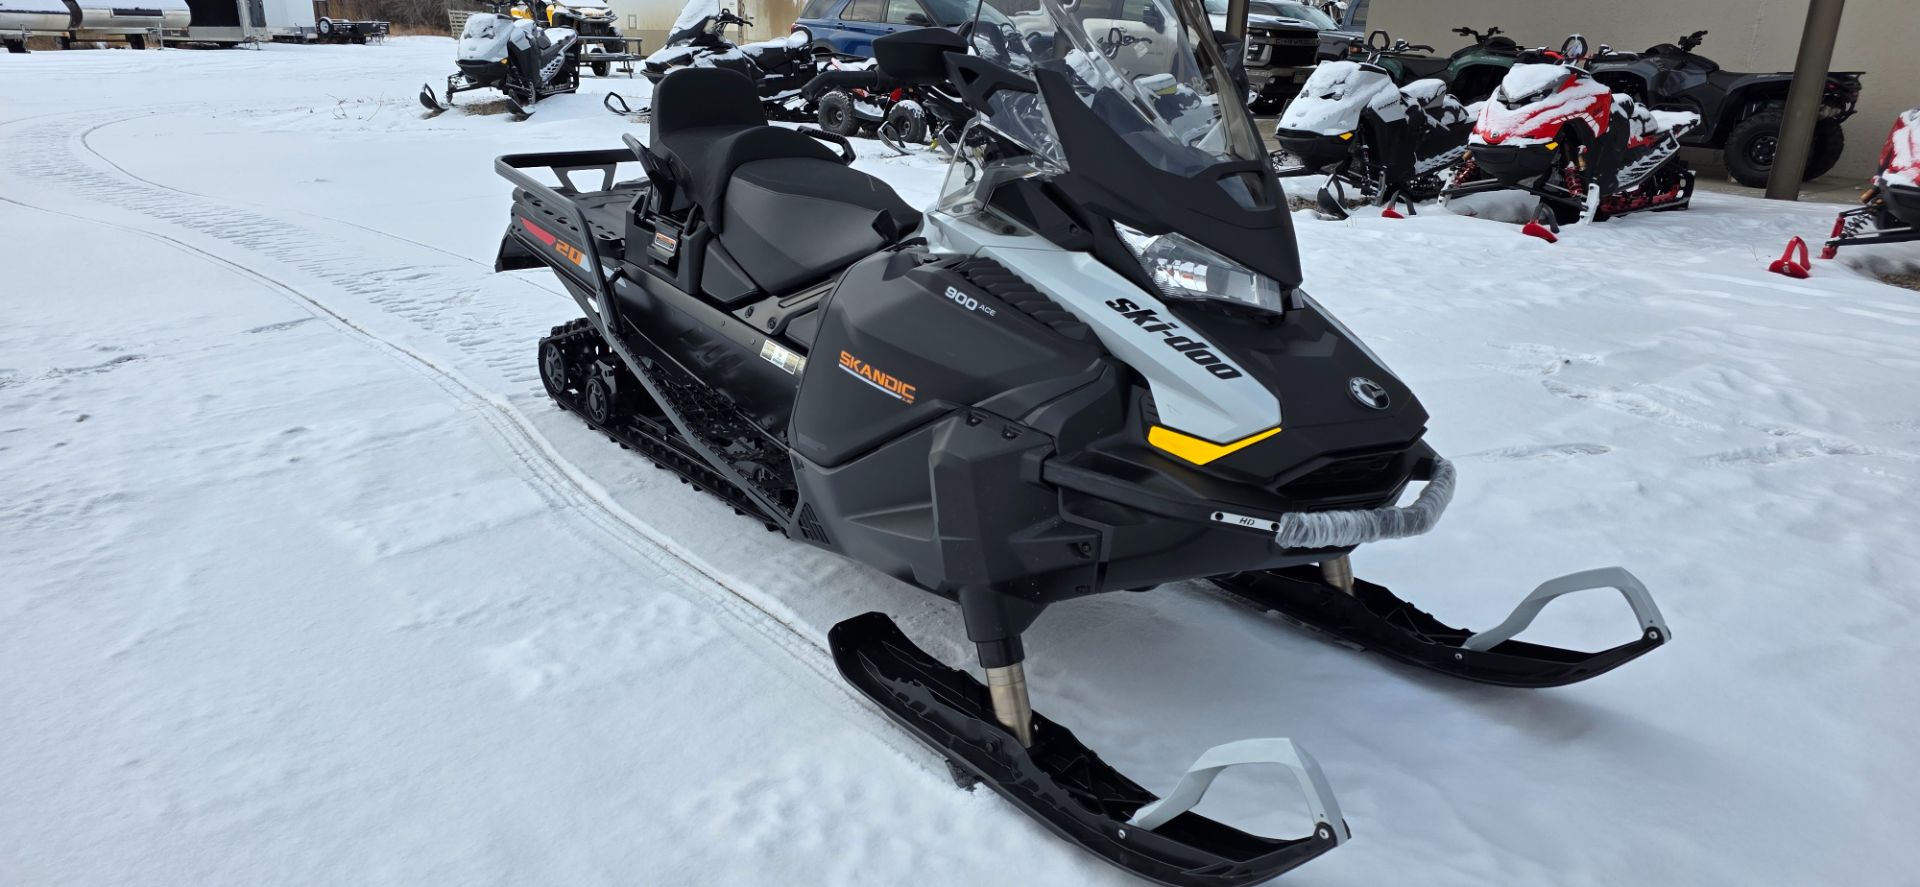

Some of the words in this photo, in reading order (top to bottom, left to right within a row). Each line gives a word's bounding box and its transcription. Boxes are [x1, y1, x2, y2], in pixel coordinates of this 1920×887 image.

[944, 286, 978, 311] 900
[978, 304, 997, 317] ACE
[1105, 298, 1243, 380] ski-doo
[839, 350, 917, 400] SKANDIC
[1239, 517, 1255, 526] HD
